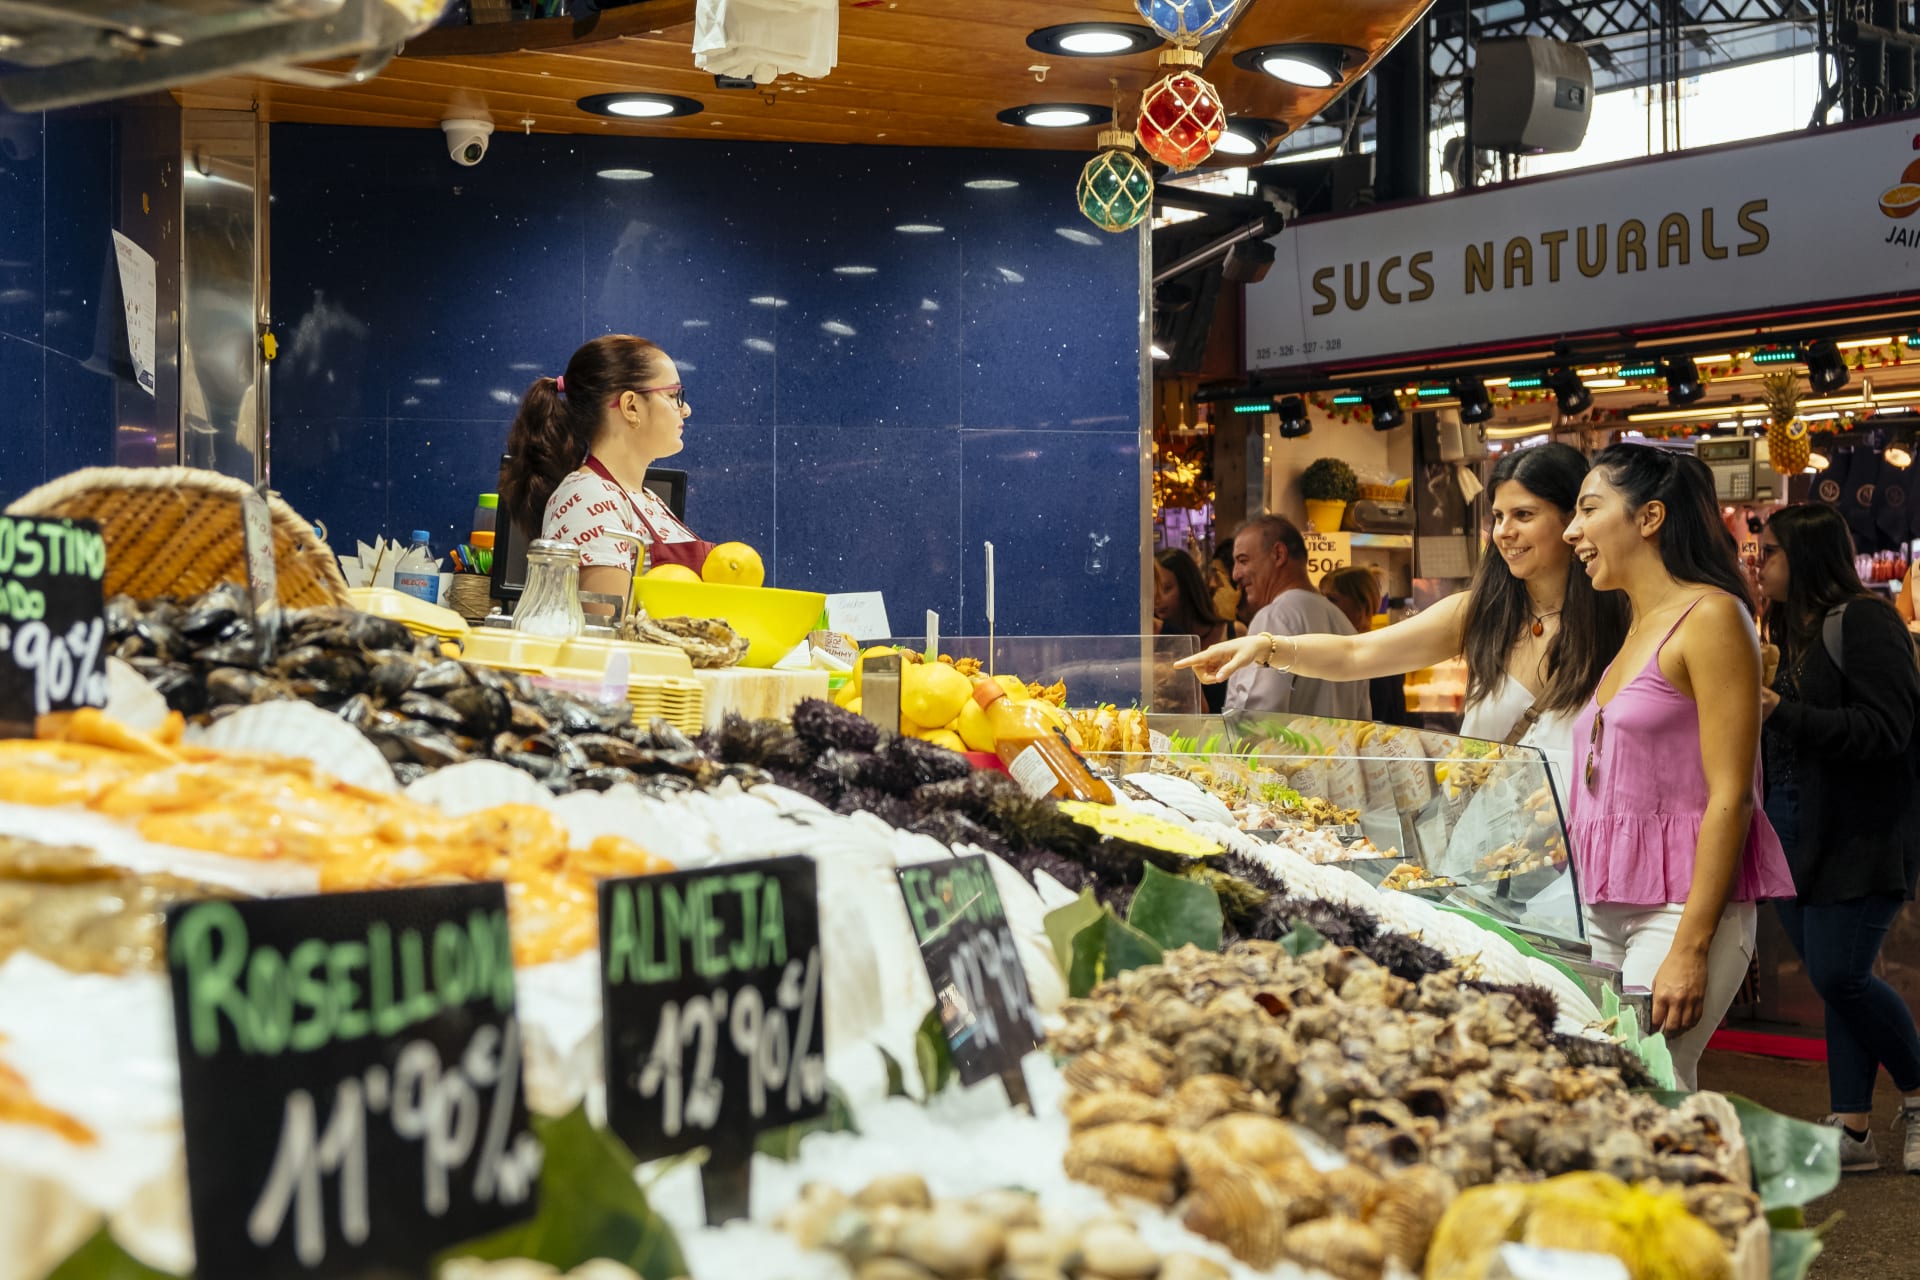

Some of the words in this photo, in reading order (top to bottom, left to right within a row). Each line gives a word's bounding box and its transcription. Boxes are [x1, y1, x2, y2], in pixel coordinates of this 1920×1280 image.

[1312, 250, 1435, 316] SUCS
[1464, 198, 1770, 295] NATURALS
[1256, 347, 1271, 360] 325
[1280, 344, 1294, 357] 326
[1303, 341, 1318, 354] 327
[1326, 338, 1342, 351] 328
[555, 493, 582, 520] LOVE
[587, 500, 618, 516] LOVE
[608, 871, 788, 985] ALMEJA
